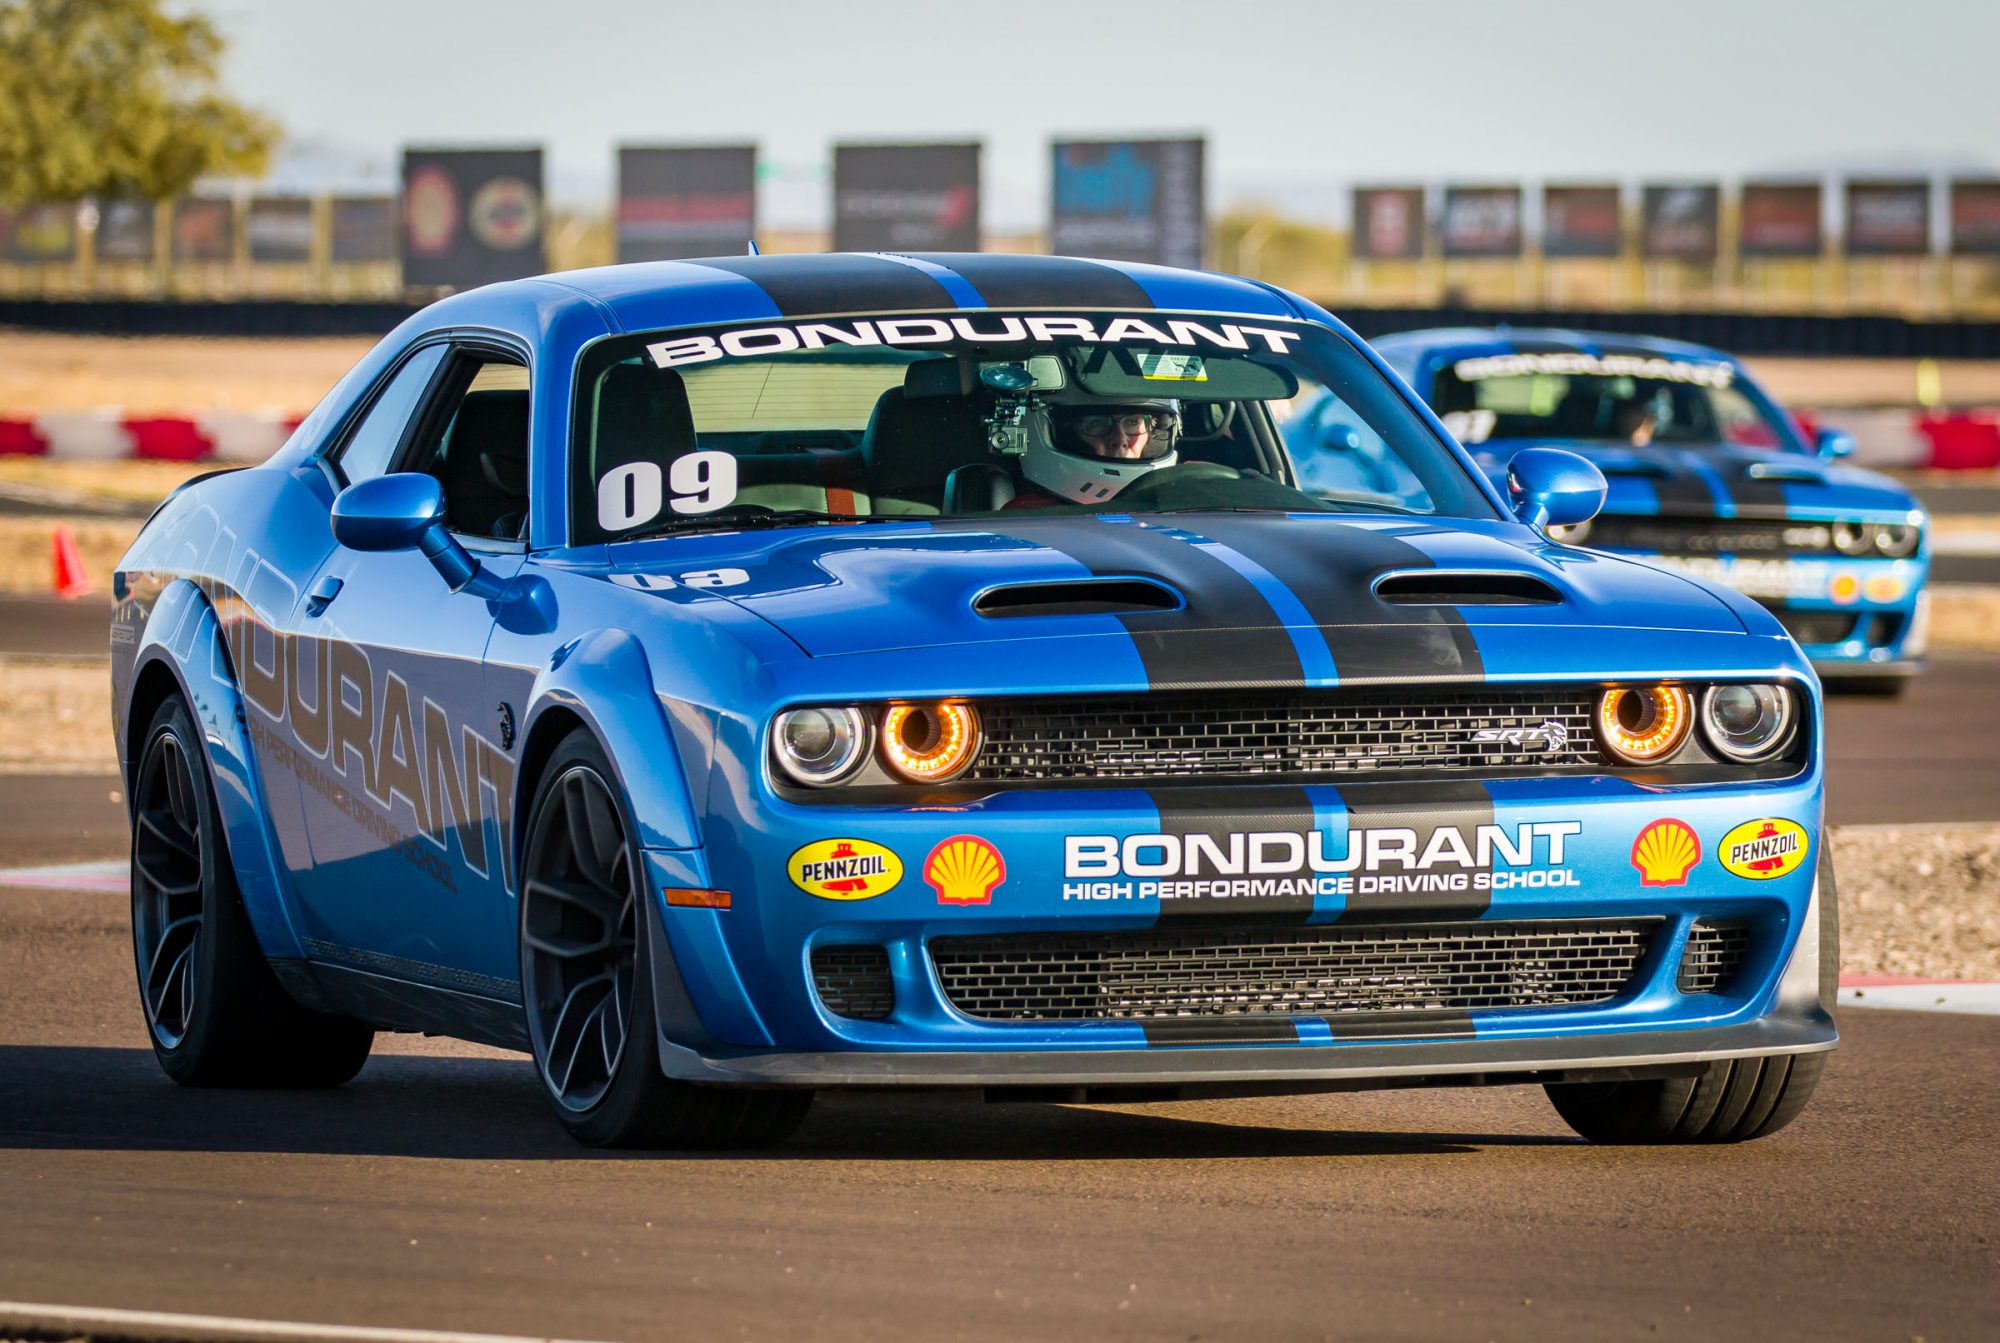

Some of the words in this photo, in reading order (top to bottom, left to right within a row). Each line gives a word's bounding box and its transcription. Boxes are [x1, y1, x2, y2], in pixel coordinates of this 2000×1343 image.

[646, 316, 1300, 369] BONDURANT
[598, 451, 737, 531] 09
[1470, 728, 1549, 745] SRT
[1064, 822, 1581, 878] BONDURANT
[1731, 833, 1797, 864] PENNZOIL
[802, 855, 885, 882] PENNZOIL
[1063, 880, 1133, 900] HIGH
[1139, 875, 1353, 900] PERFORMANCE
[1359, 871, 1467, 894] DRIVING
[1473, 868, 1581, 890] SCHOOL
